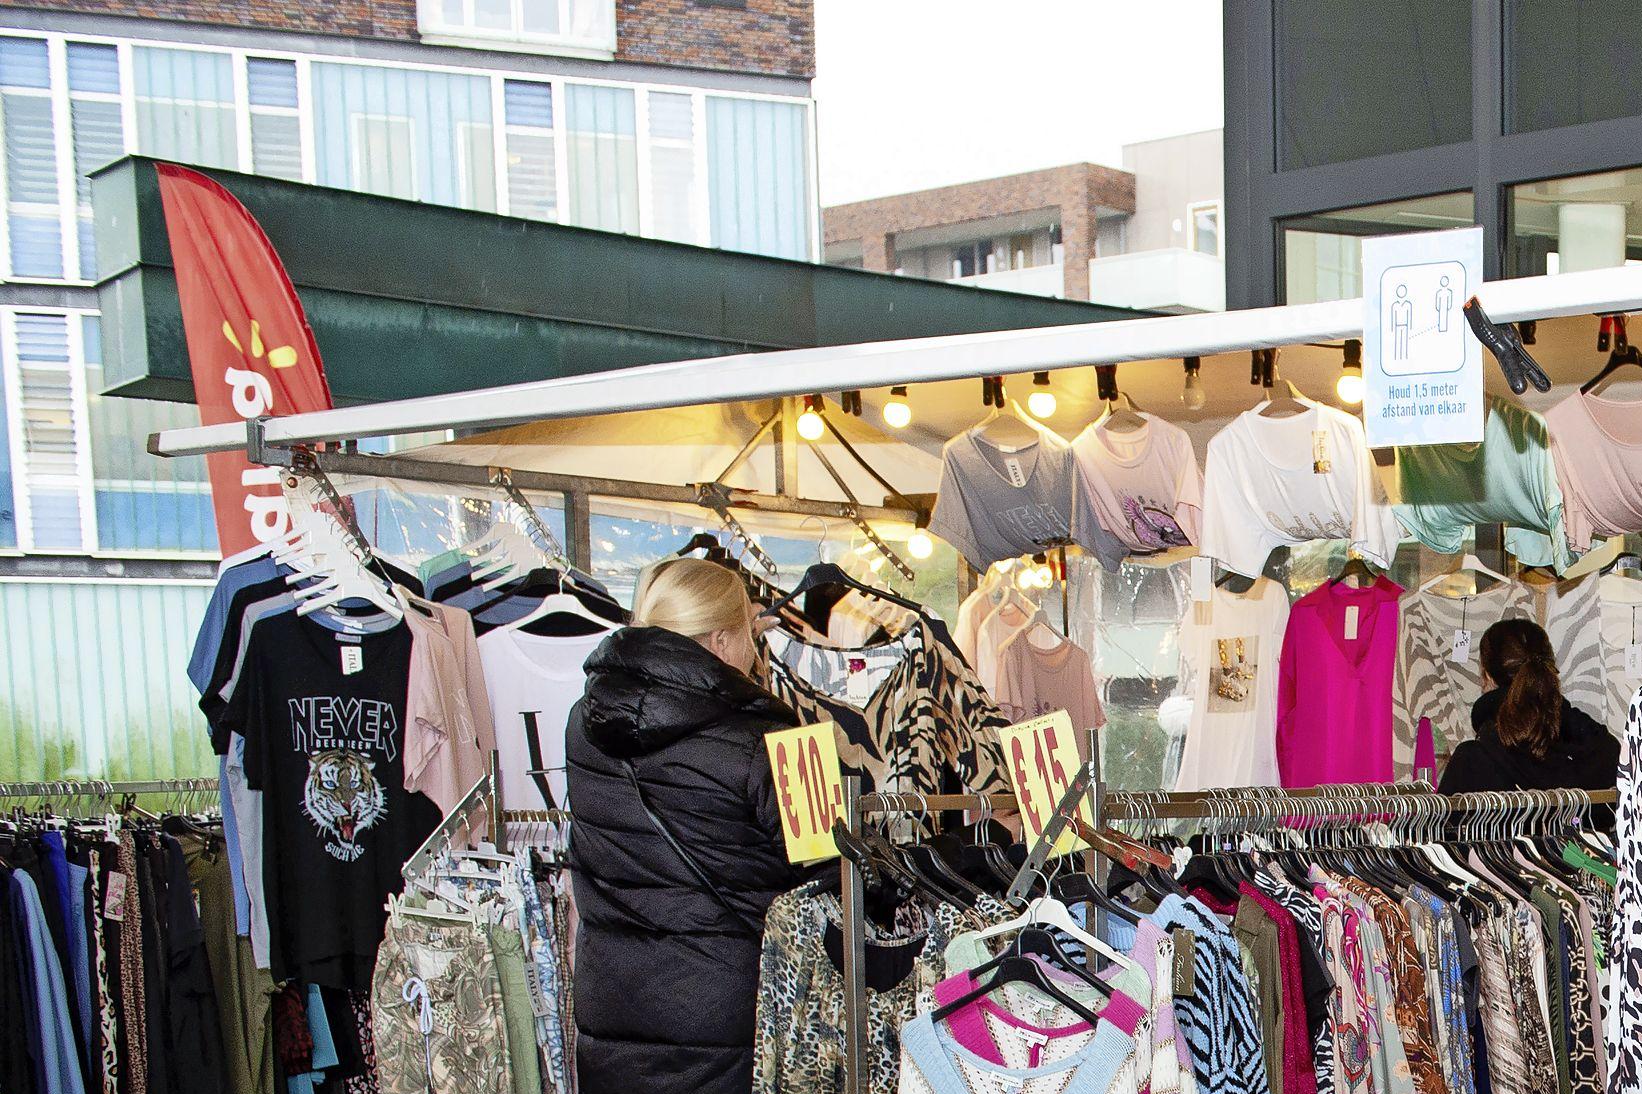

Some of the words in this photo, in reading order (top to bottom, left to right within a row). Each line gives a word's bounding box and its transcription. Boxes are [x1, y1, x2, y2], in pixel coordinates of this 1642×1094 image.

[1388, 384, 1411, 400] Houd
[1414, 383, 1428, 400] 1,5
[1430, 382, 1458, 397] meter
[1382, 402, 1416, 418] afstand
[1418, 404, 1435, 416] van
[1437, 400, 1466, 415] elkaar
[287, 696, 398, 763] NEVER
[315, 738, 344, 749] BEEN
[324, 841, 350, 862] SUCH
